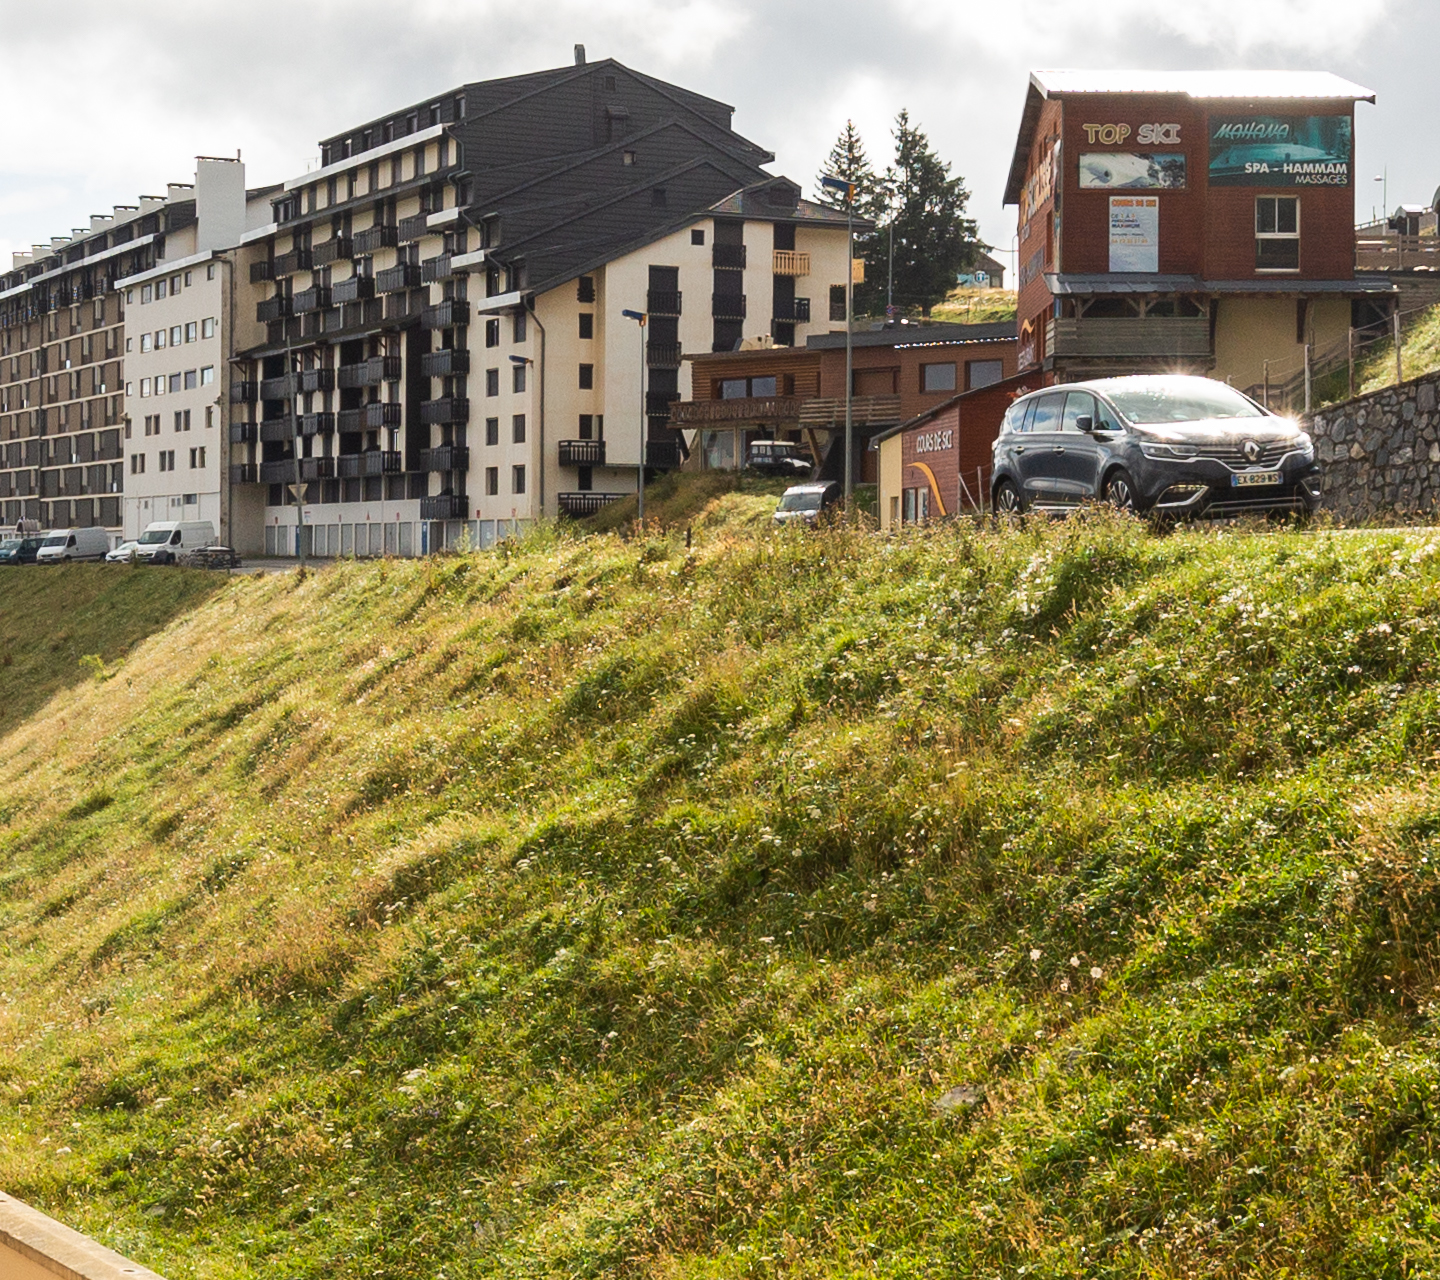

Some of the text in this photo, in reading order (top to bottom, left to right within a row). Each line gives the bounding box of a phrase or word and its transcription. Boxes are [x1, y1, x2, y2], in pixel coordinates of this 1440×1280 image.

[1082, 123, 1181, 145] TOP SKI
[1213, 122, 1290, 140] MAHANA
[1244, 163, 1269, 173] SPA
[1283, 163, 1347, 174] HAMMAM
[1295, 174, 1347, 184] MASSAGES
